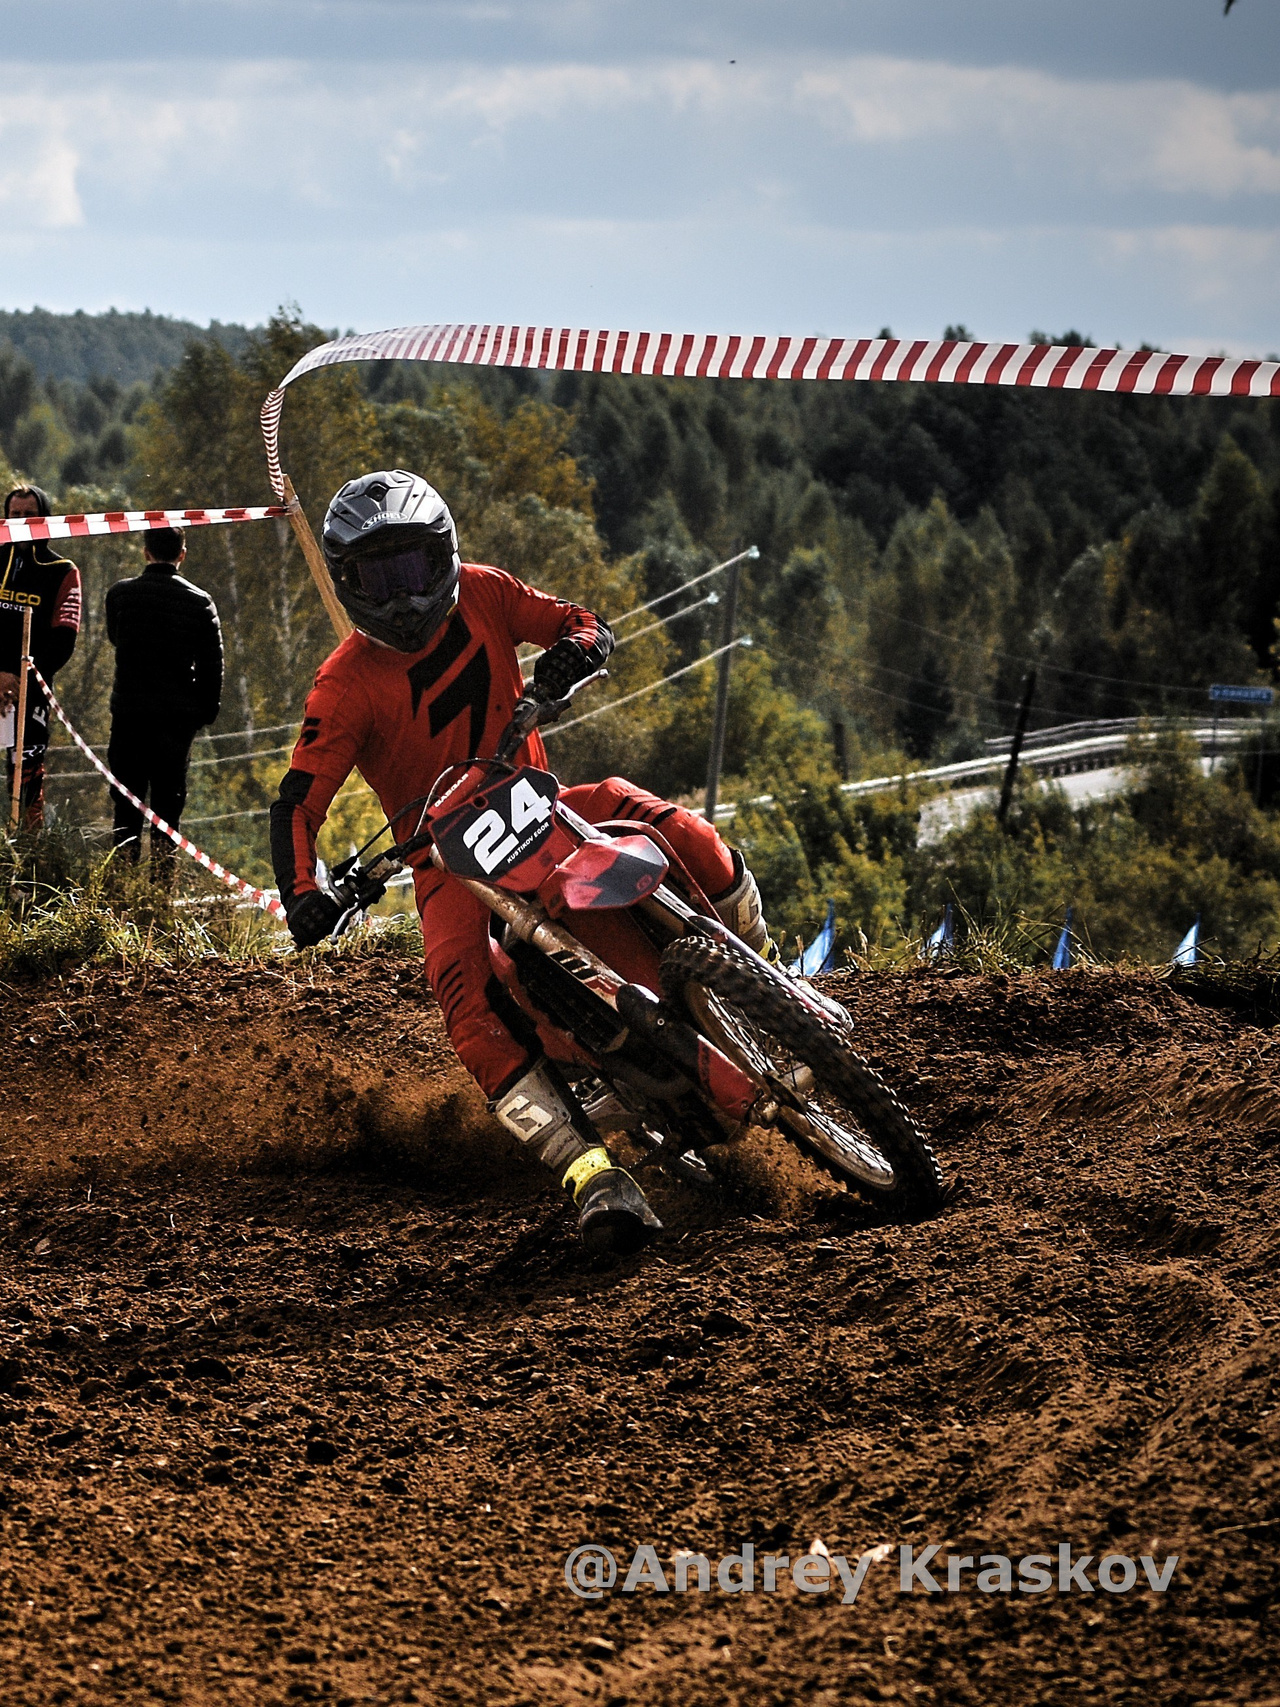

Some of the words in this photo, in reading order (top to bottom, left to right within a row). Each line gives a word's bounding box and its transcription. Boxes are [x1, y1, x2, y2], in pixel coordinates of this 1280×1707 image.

[463, 777, 552, 875] 24
[506, 834, 534, 864] KUSTIKOV
[533, 821, 550, 839] EGOR
